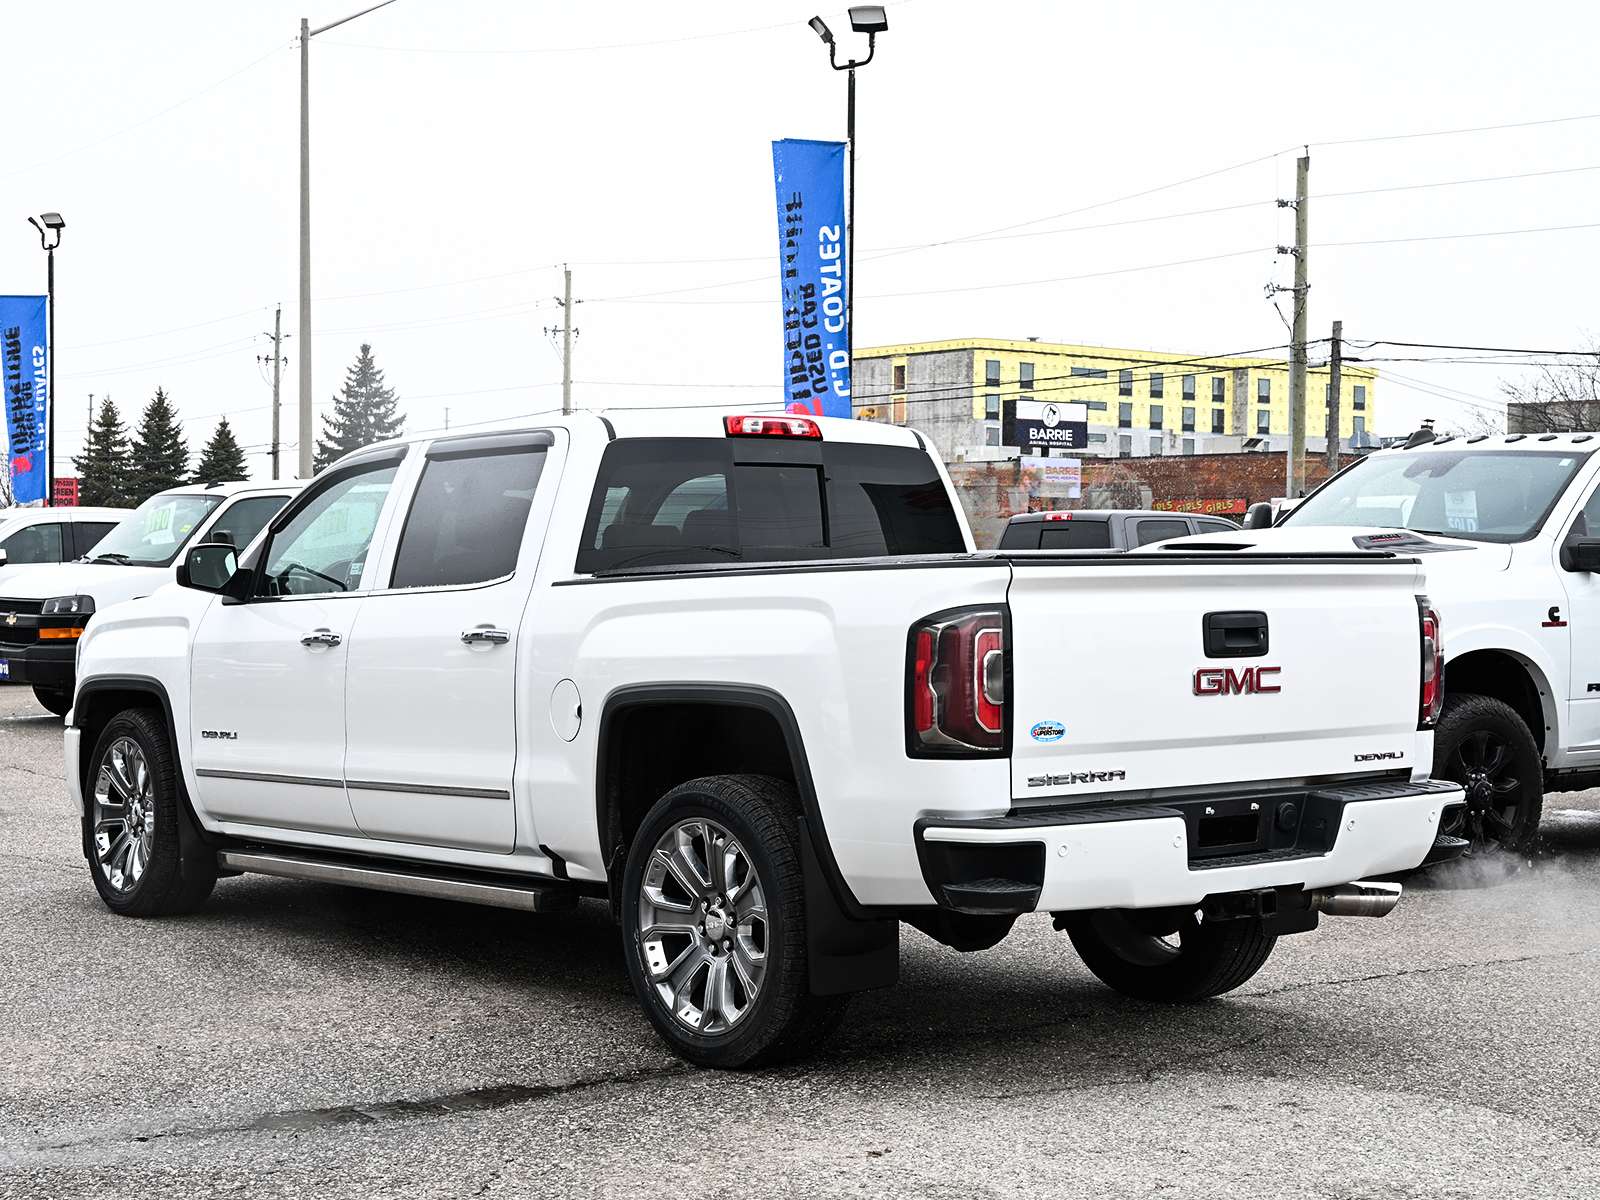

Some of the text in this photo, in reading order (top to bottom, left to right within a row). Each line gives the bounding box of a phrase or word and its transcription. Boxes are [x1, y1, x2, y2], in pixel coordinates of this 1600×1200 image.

[1029, 427, 1073, 441] BARRIE
[1045, 466, 1080, 476] BARRIE
[1177, 500, 1203, 513] GIRLS
[1206, 501, 1234, 513] GIRLS
[1192, 665, 1281, 697] GMC
[201, 730, 237, 740] DENALI
[1353, 750, 1404, 762] DENALI
[1027, 768, 1126, 788] SIERRA
